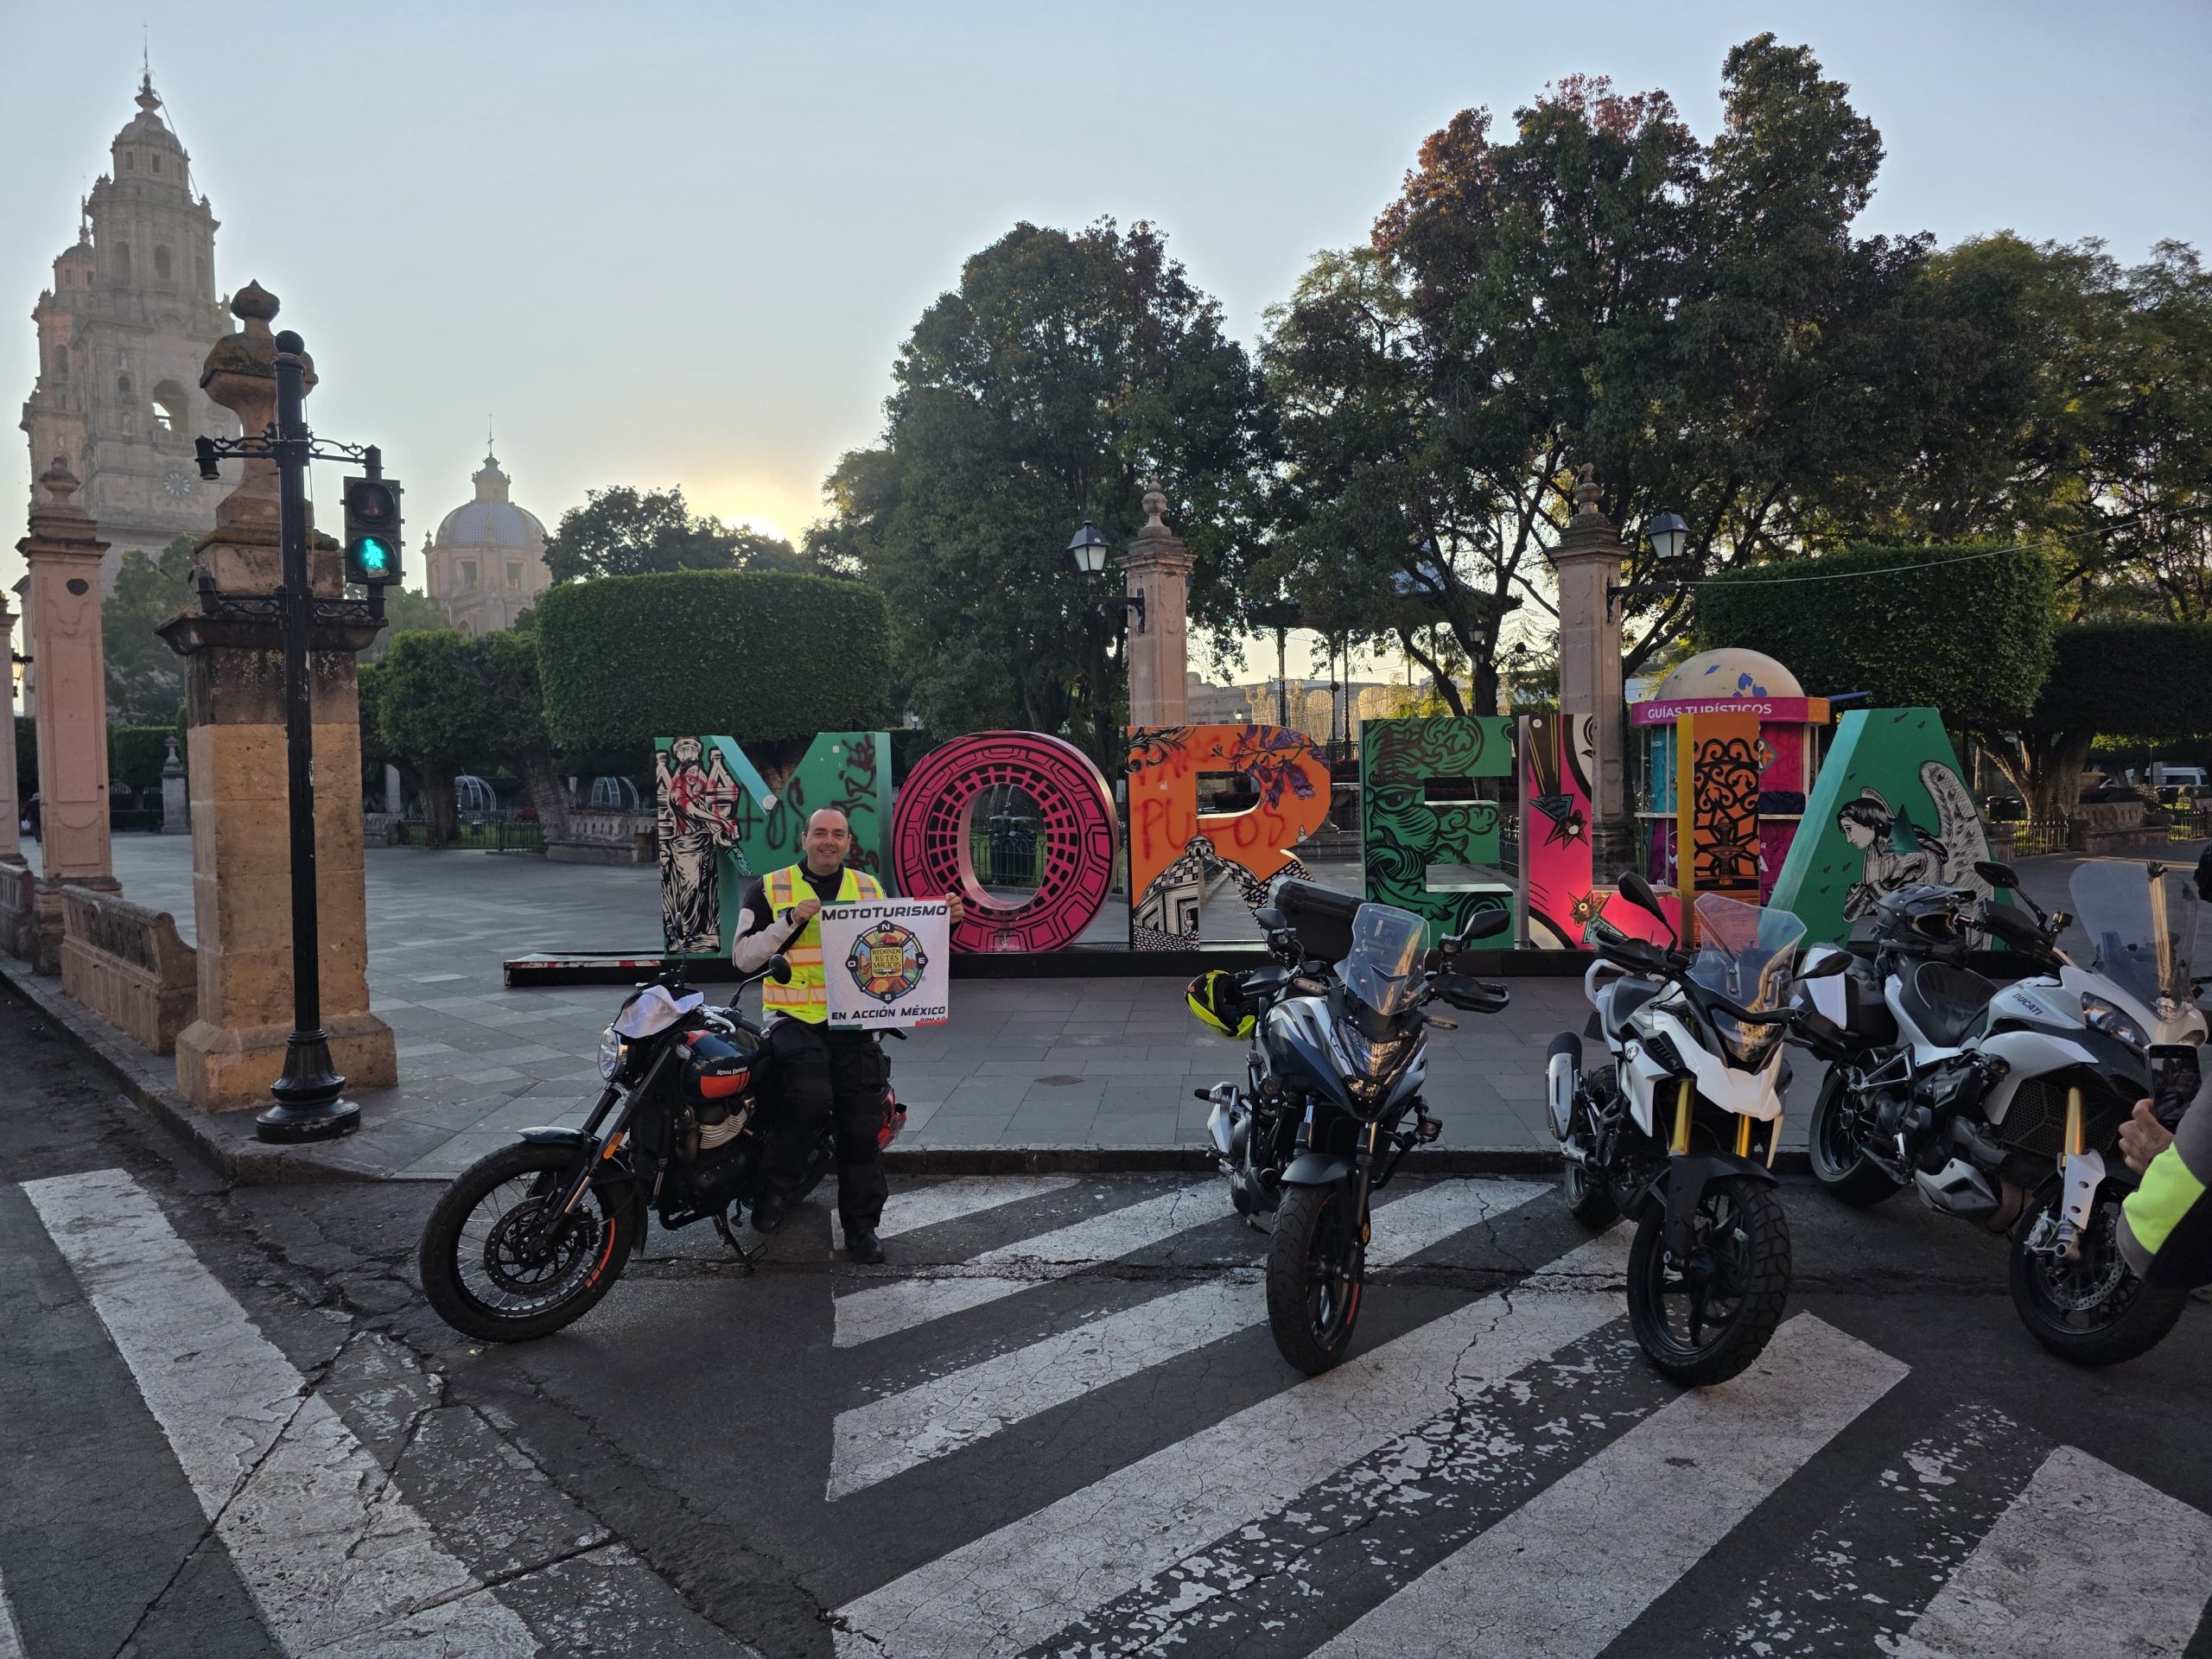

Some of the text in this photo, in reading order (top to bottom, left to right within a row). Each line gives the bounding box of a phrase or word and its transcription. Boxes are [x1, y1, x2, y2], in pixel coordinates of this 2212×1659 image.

[1648, 705, 1682, 719] GUÍAS
[822, 906, 948, 921] MOTOTURISMO
[2012, 993, 2044, 1015] DUCATI
[851, 1006, 896, 1020] ACCIÓN
[900, 1005, 945, 1017] MÉXICO
